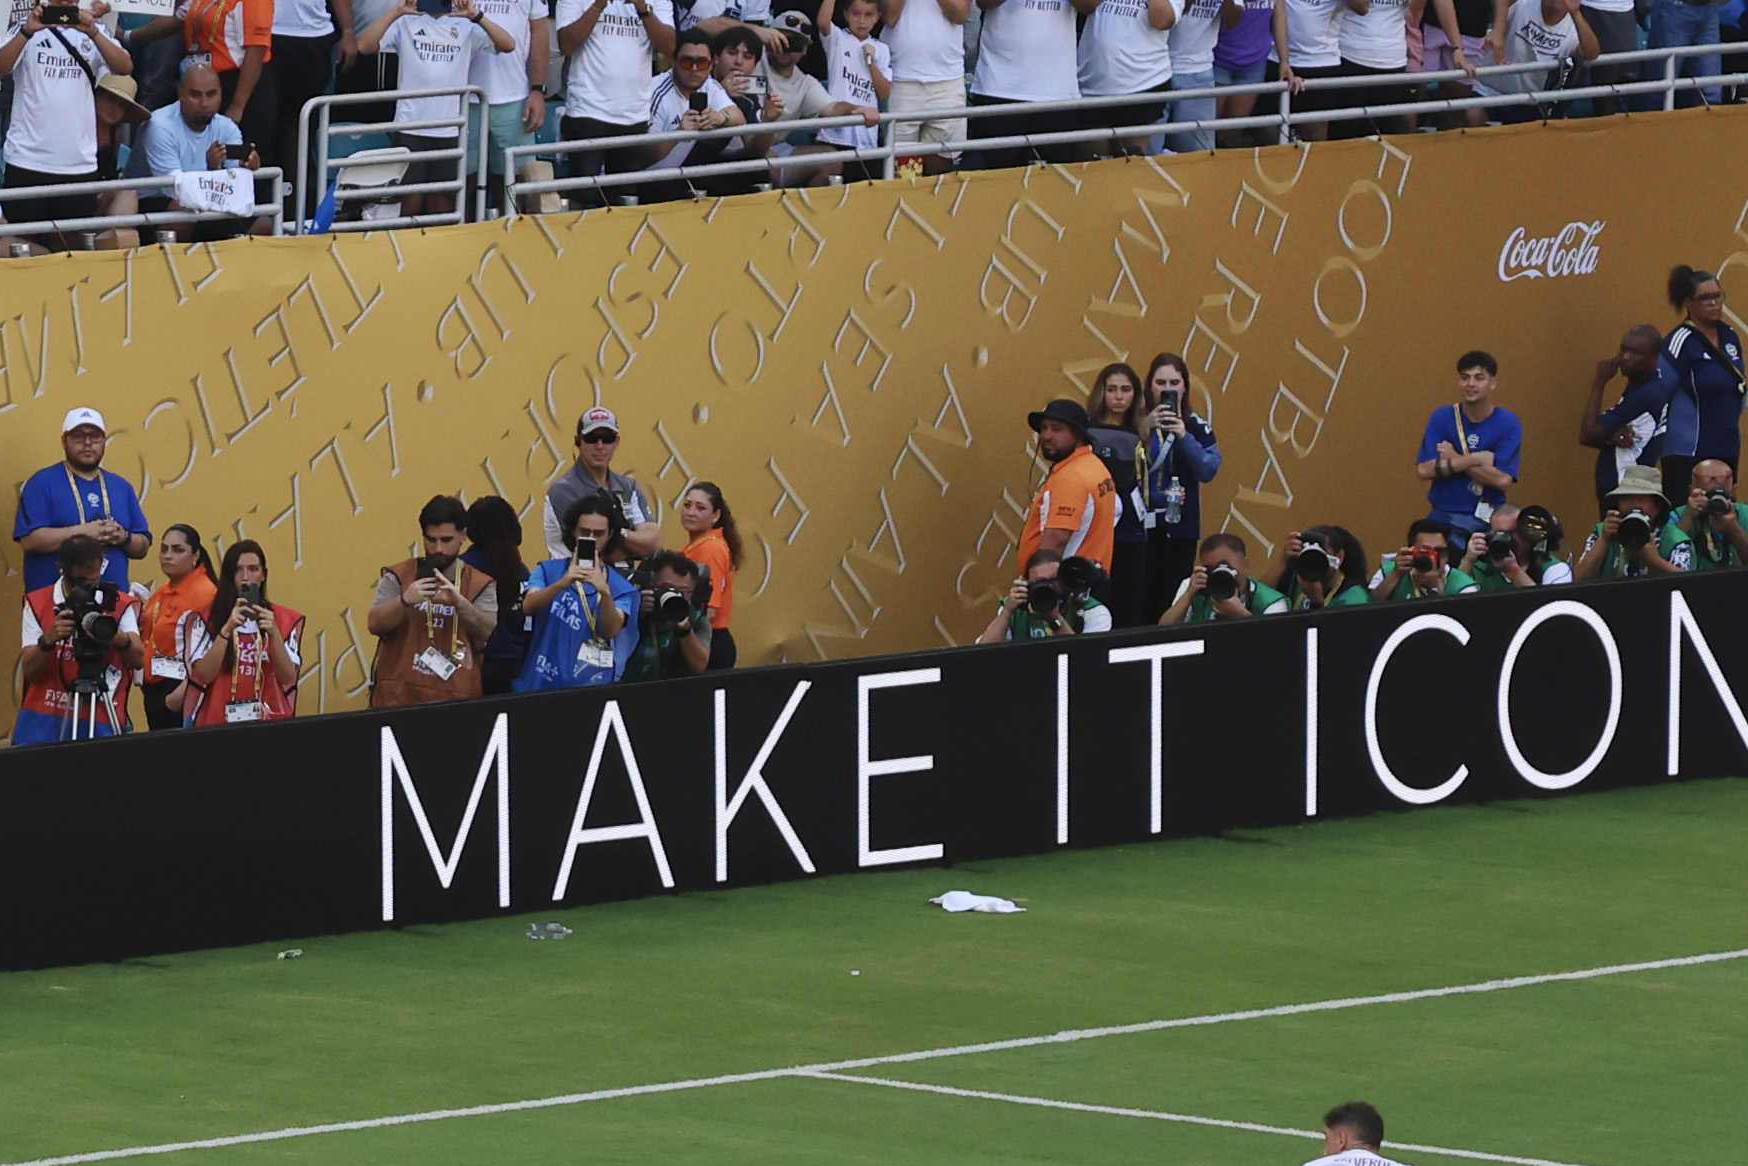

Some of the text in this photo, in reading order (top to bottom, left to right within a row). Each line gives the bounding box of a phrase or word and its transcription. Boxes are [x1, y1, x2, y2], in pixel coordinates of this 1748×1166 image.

[58, 67, 82, 79] BETTER
[382, 668, 943, 920] MAKE
[1058, 640, 1204, 843] IT
[1307, 591, 1748, 815] ICON
